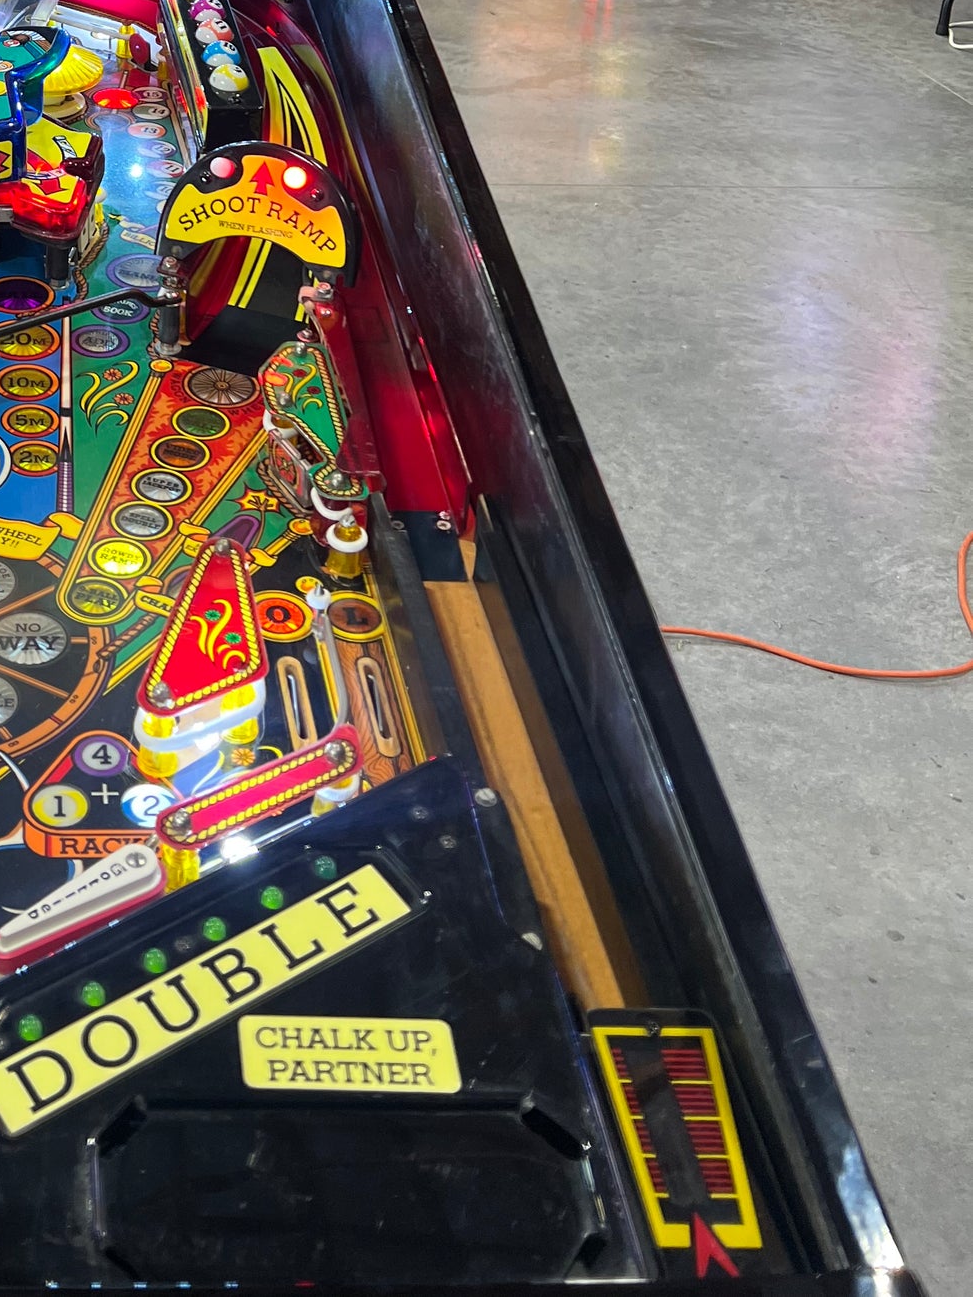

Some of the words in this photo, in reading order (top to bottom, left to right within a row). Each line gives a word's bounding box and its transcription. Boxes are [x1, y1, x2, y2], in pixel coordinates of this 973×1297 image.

[151, 107, 165, 115] 14
[165, 165, 179, 173] 11
[179, 196, 261, 232] SHOOT
[267, 202, 337, 251] RAMP
[218, 220, 245, 231] WHEN
[103, 305, 134, 317] 500K
[0, 333, 47, 346] 20M
[8, 377, 45, 388] 10M
[15, 415, 46, 426] 5M
[19, 451, 50, 463] 2M
[266, 605, 291, 624] O
[343, 607, 369, 625] L
[15, 623, 41, 632] NO
[92, 745, 112, 765] 4
[53, 796, 66, 817] 1
[143, 795, 160, 816] 2
[60, 838, 148, 854] RAC
[7, 882, 380, 1113] DOUBLE
[255, 1026, 378, 1051] CHALK
[385, 1029, 437, 1057] UP,
[267, 1059, 435, 1086] PARTNER
